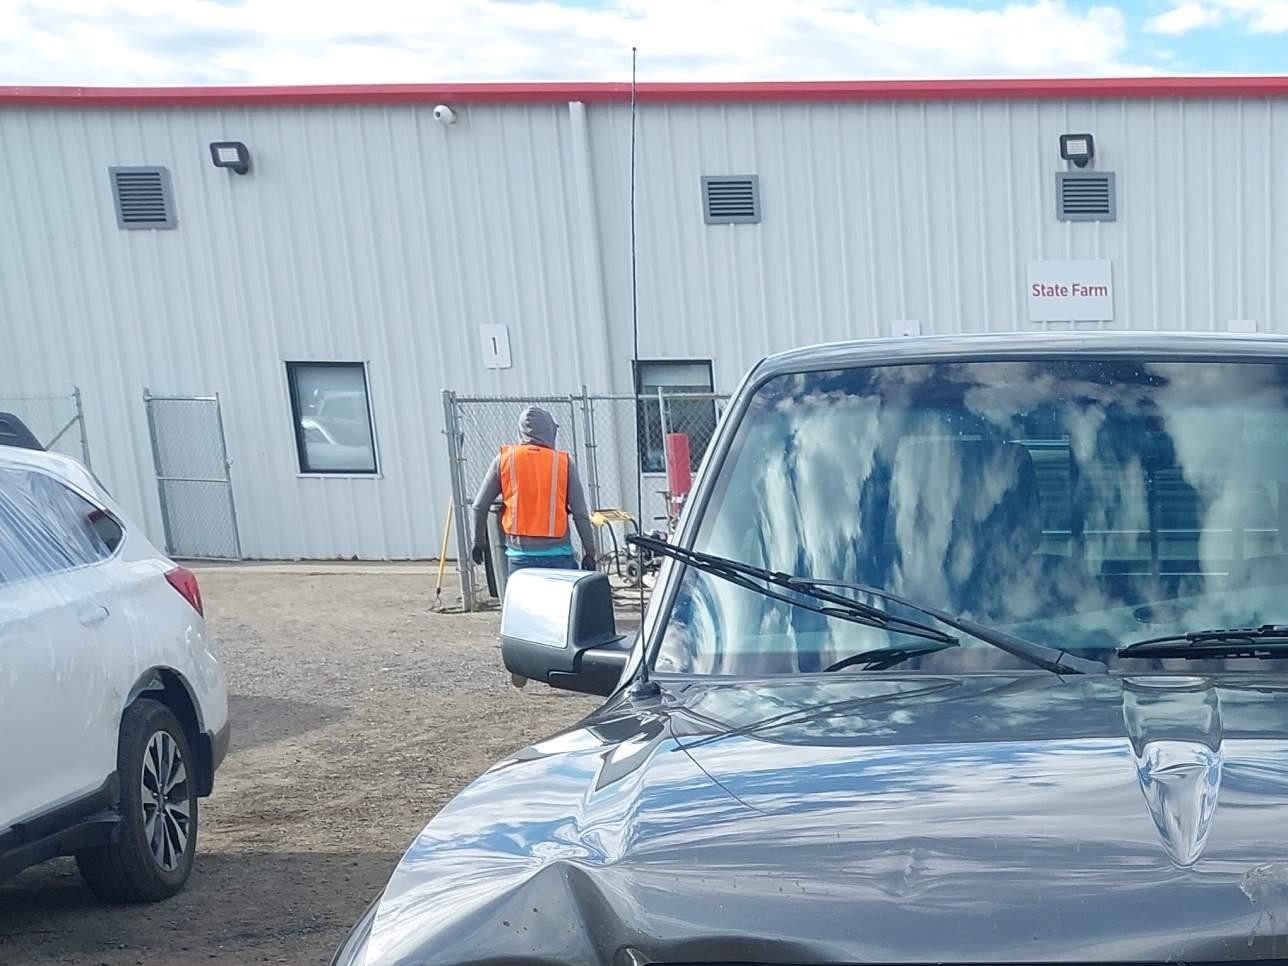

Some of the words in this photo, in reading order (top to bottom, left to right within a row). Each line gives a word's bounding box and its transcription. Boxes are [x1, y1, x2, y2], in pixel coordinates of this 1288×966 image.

[1031, 283, 1069, 297] State
[1072, 283, 1108, 297] Farm
[491, 336, 498, 356] 1
